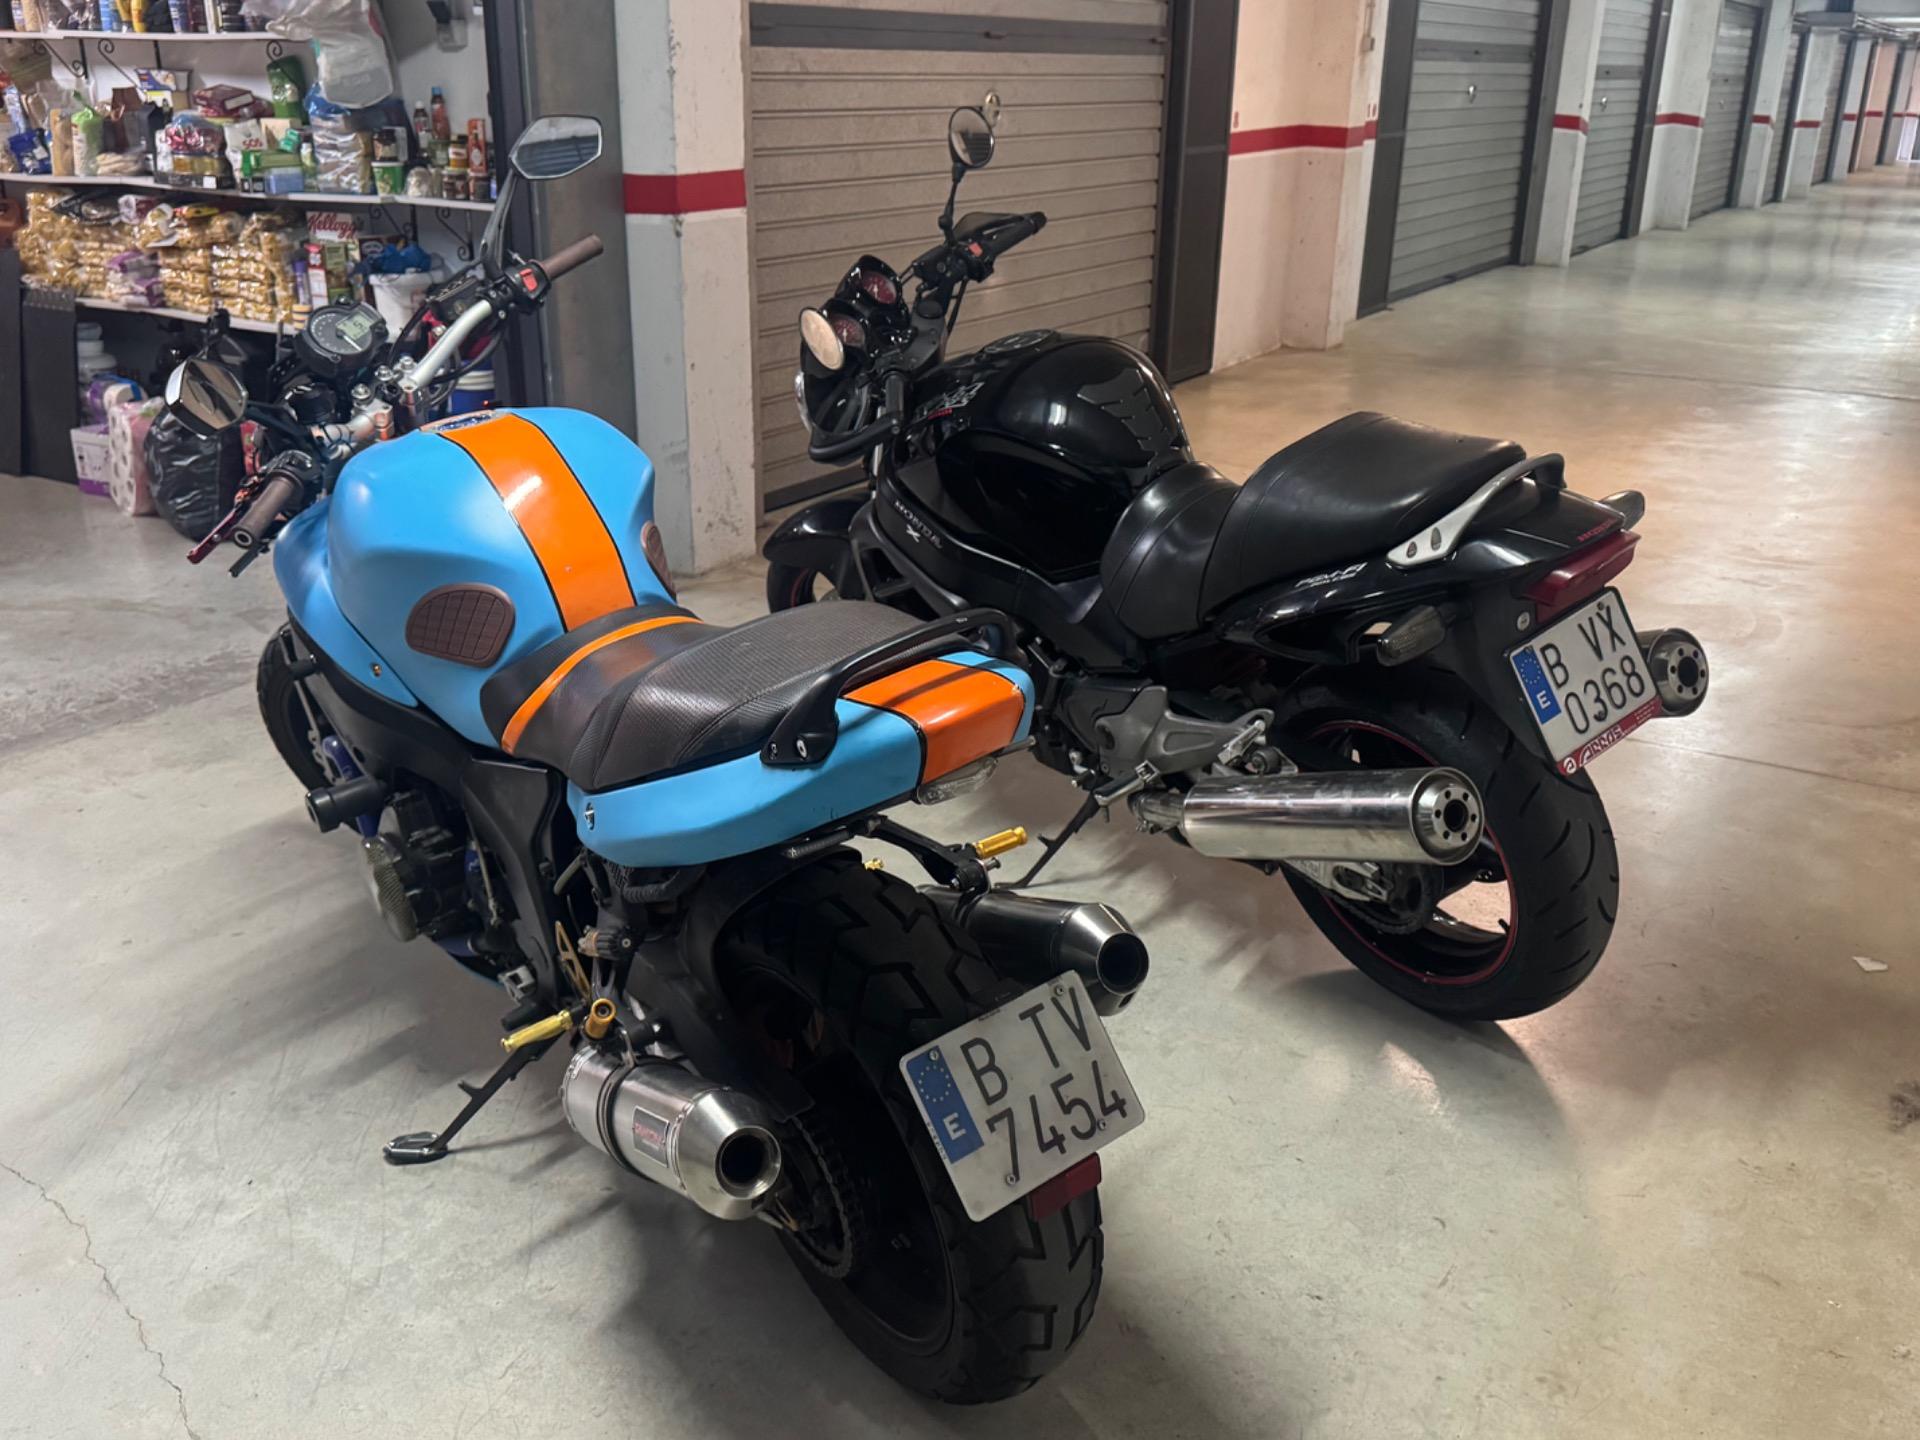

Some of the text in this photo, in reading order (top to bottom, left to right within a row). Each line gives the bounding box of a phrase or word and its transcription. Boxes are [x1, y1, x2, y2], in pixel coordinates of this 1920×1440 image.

[894, 499, 943, 549] HONDA
[1540, 606, 1627, 690] B VX
[1535, 691, 1551, 710] E
[1564, 655, 1645, 735] 0368
[960, 986, 1091, 1106] B TV
[942, 1112, 967, 1141] E
[986, 1059, 1127, 1182] 7454
